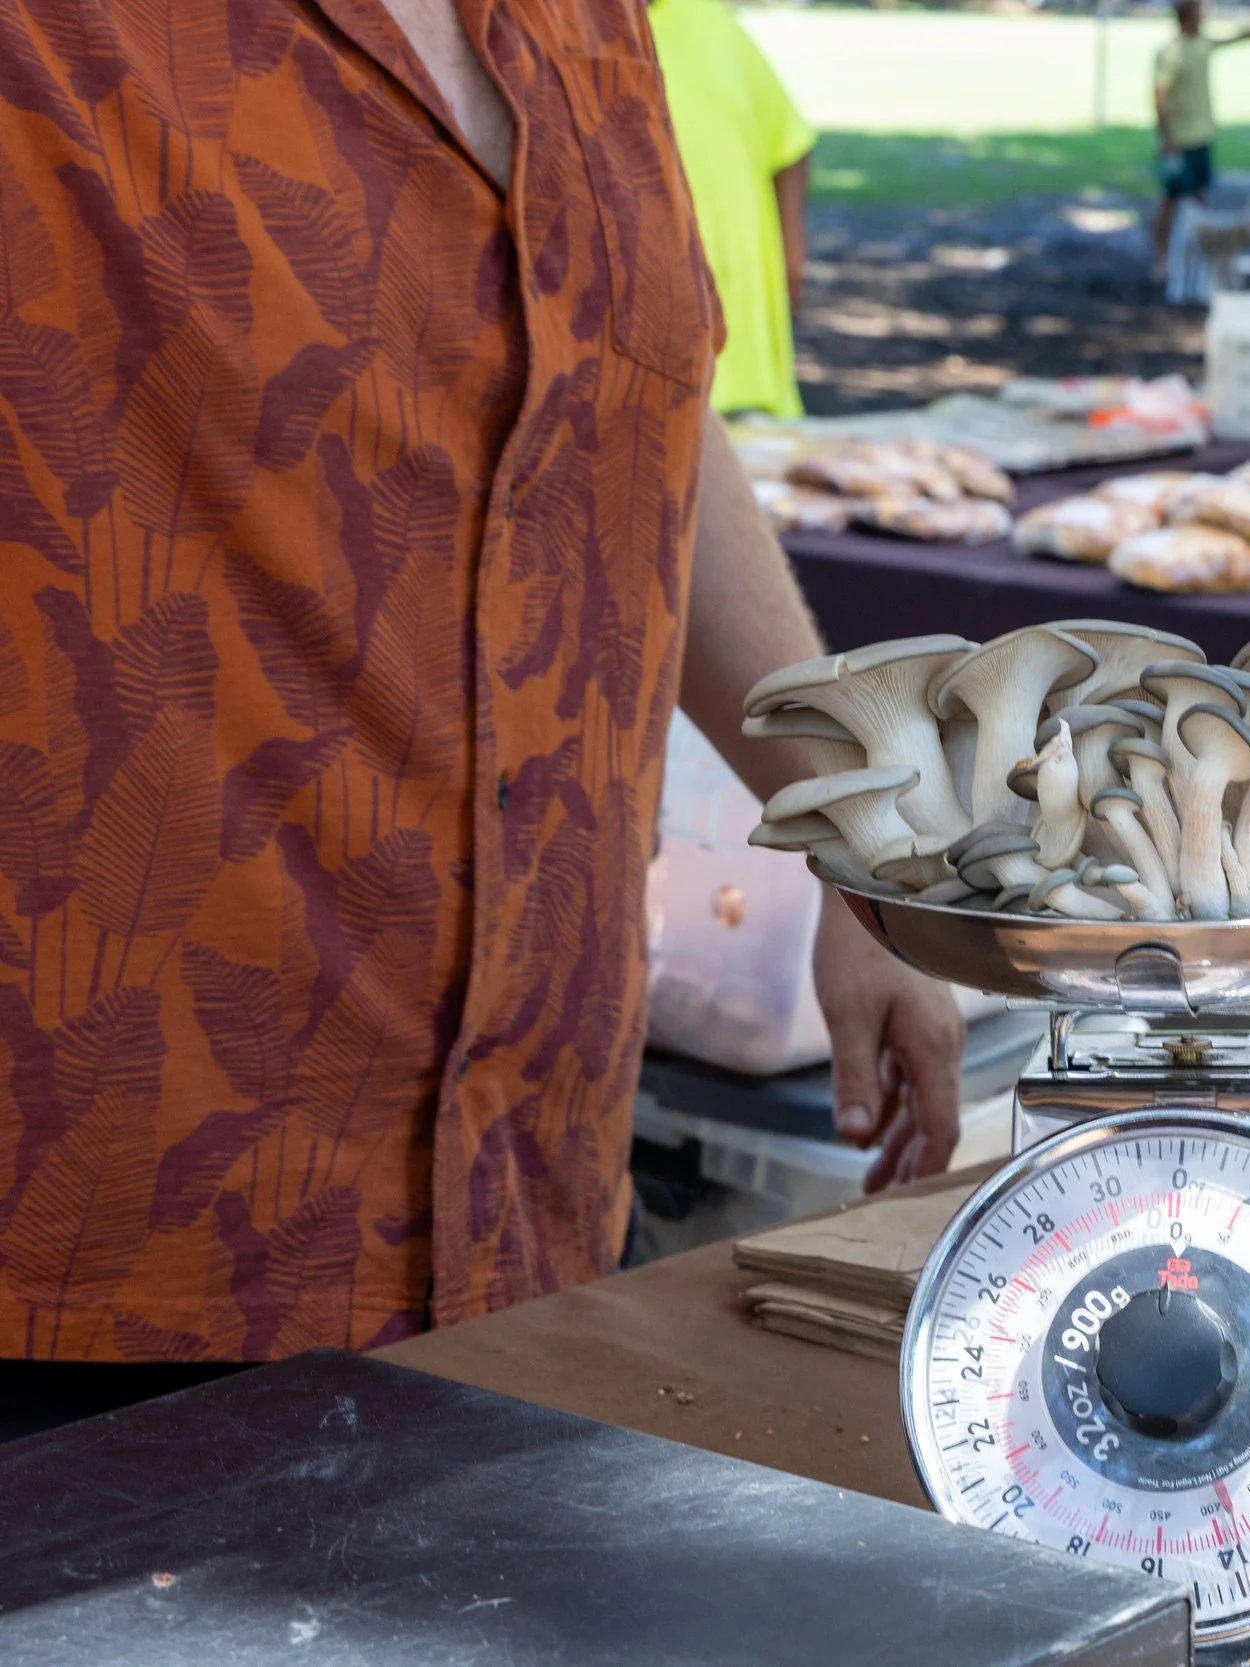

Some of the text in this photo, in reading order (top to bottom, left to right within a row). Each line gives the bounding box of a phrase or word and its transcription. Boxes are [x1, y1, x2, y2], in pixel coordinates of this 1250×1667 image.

[1089, 1176, 1122, 1202] 30
[1022, 1213, 1055, 1245] 28
[978, 1272, 1007, 1304] 26
[1061, 1285, 1131, 1352] 900g
[961, 1344, 985, 1380] 24
[968, 1418, 995, 1452] 22
[1002, 1484, 1035, 1518] 20
[1150, 1510, 1171, 1521] 450
[1066, 1535, 1091, 1557] 18
[1217, 1543, 1249, 1570] 14
[1140, 1557, 1163, 1578] 16
